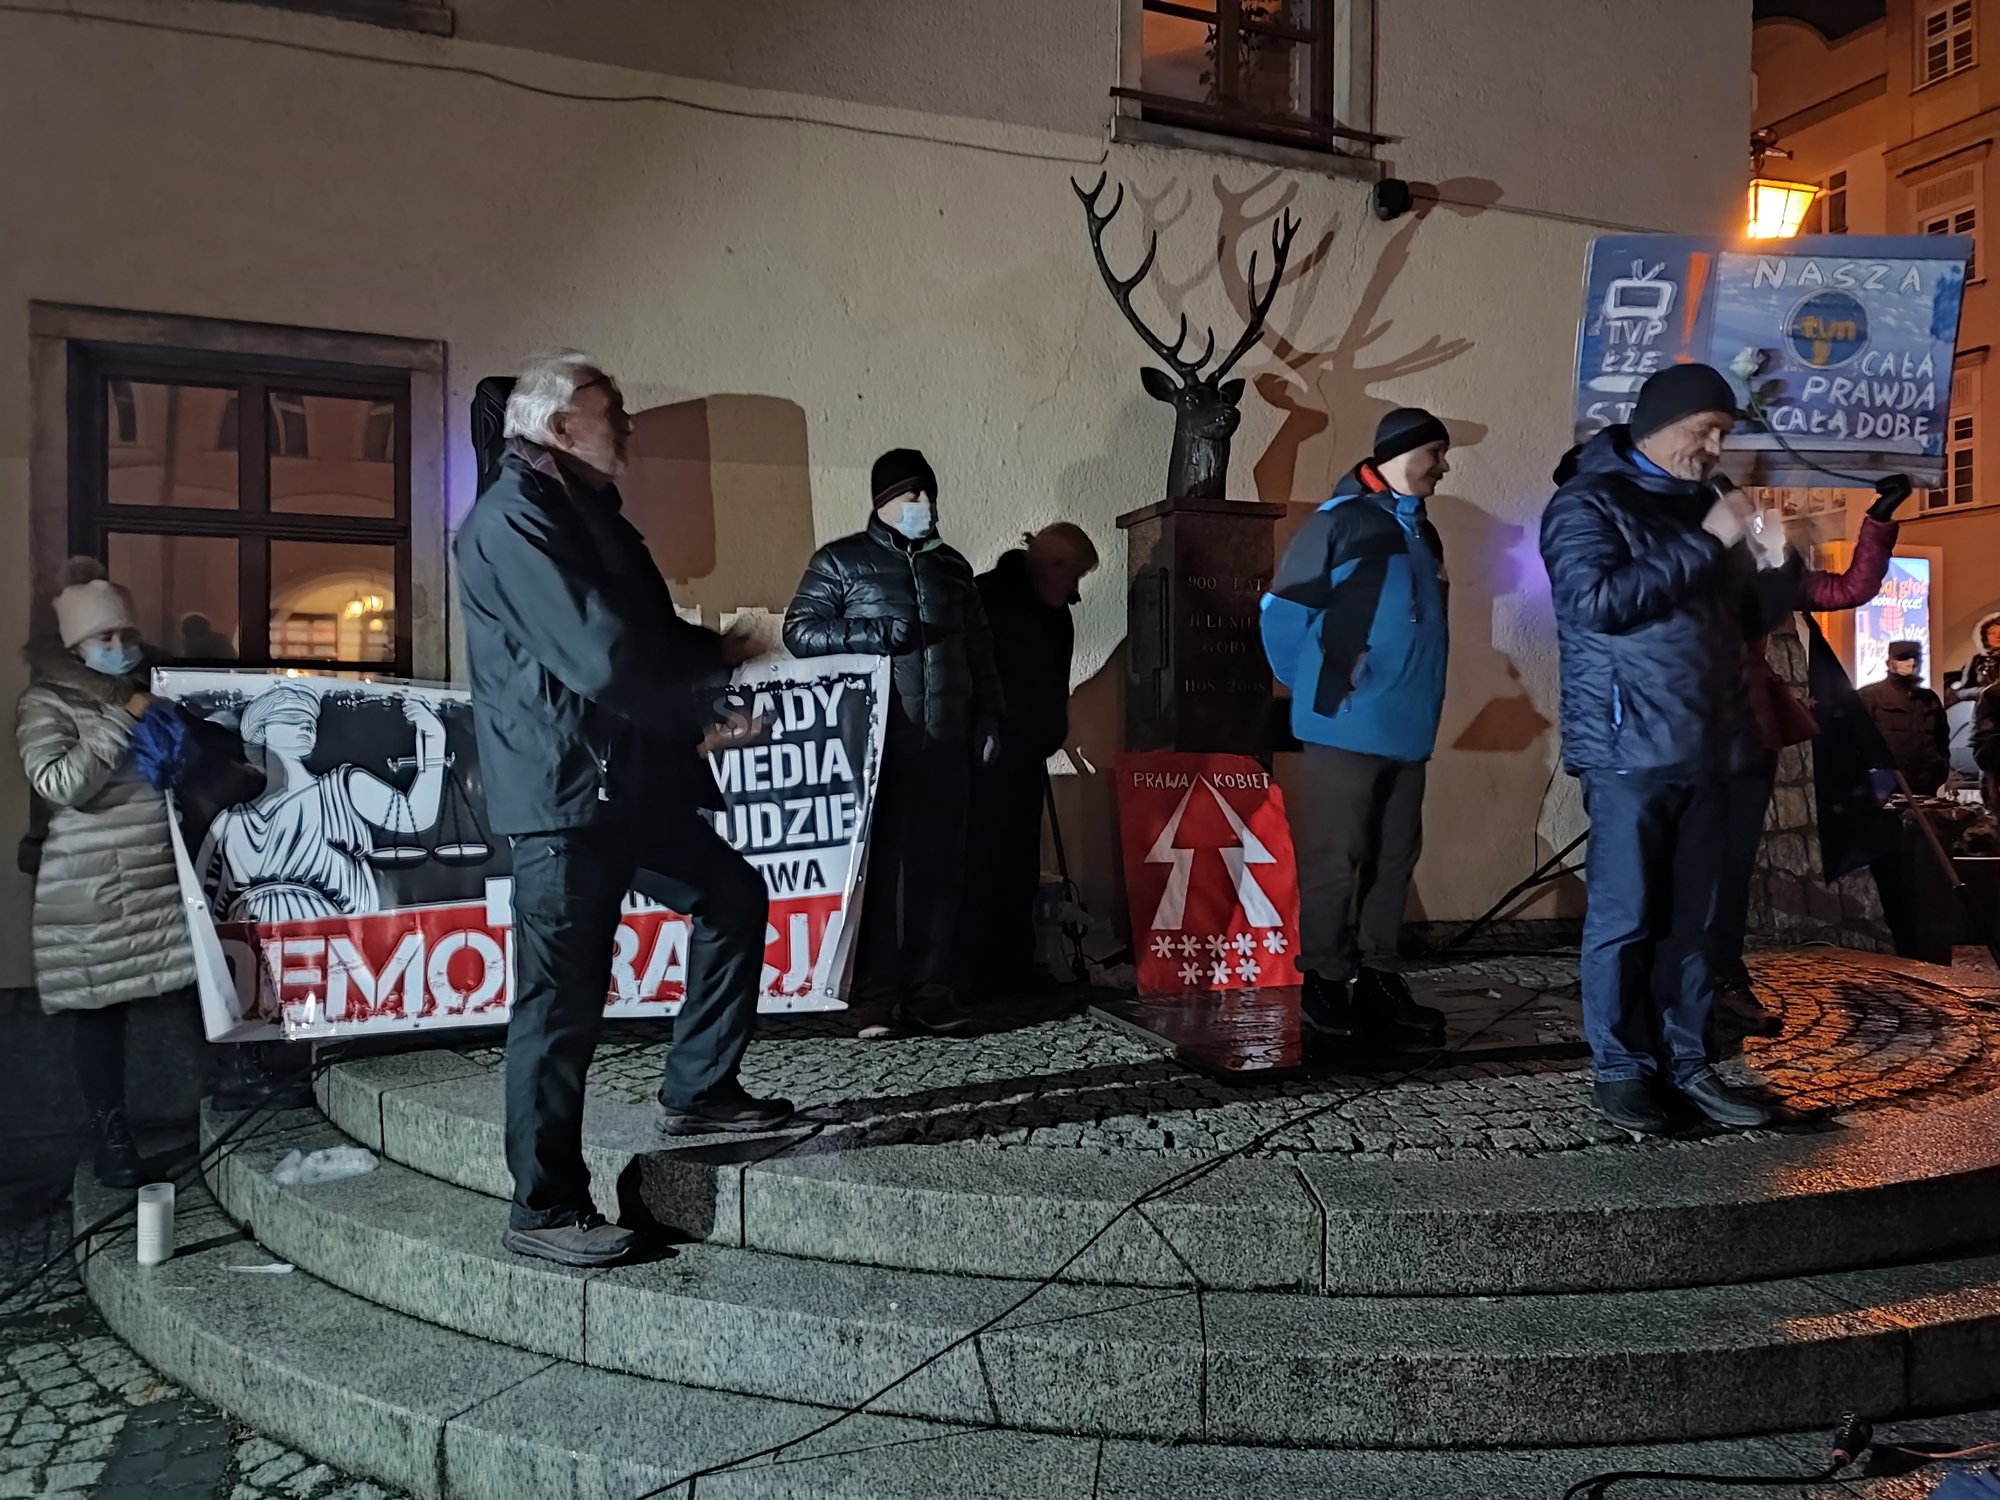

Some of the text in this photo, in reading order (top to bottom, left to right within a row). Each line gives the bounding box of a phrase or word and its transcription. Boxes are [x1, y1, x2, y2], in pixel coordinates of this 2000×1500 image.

[1752, 259, 1922, 294] NASZA
[1605, 320, 1667, 346] TVP
[1861, 351, 1934, 379] CAŁA
[1802, 376, 1936, 410] PRAWDA
[1771, 405, 1930, 448] CAŁĄ DOBĘ
[1187, 575, 1217, 590] 900
[713, 681, 845, 741] SĄDY
[1132, 772, 1270, 789] PRAWA KOBIET
[713, 793, 856, 850] UDZIE
